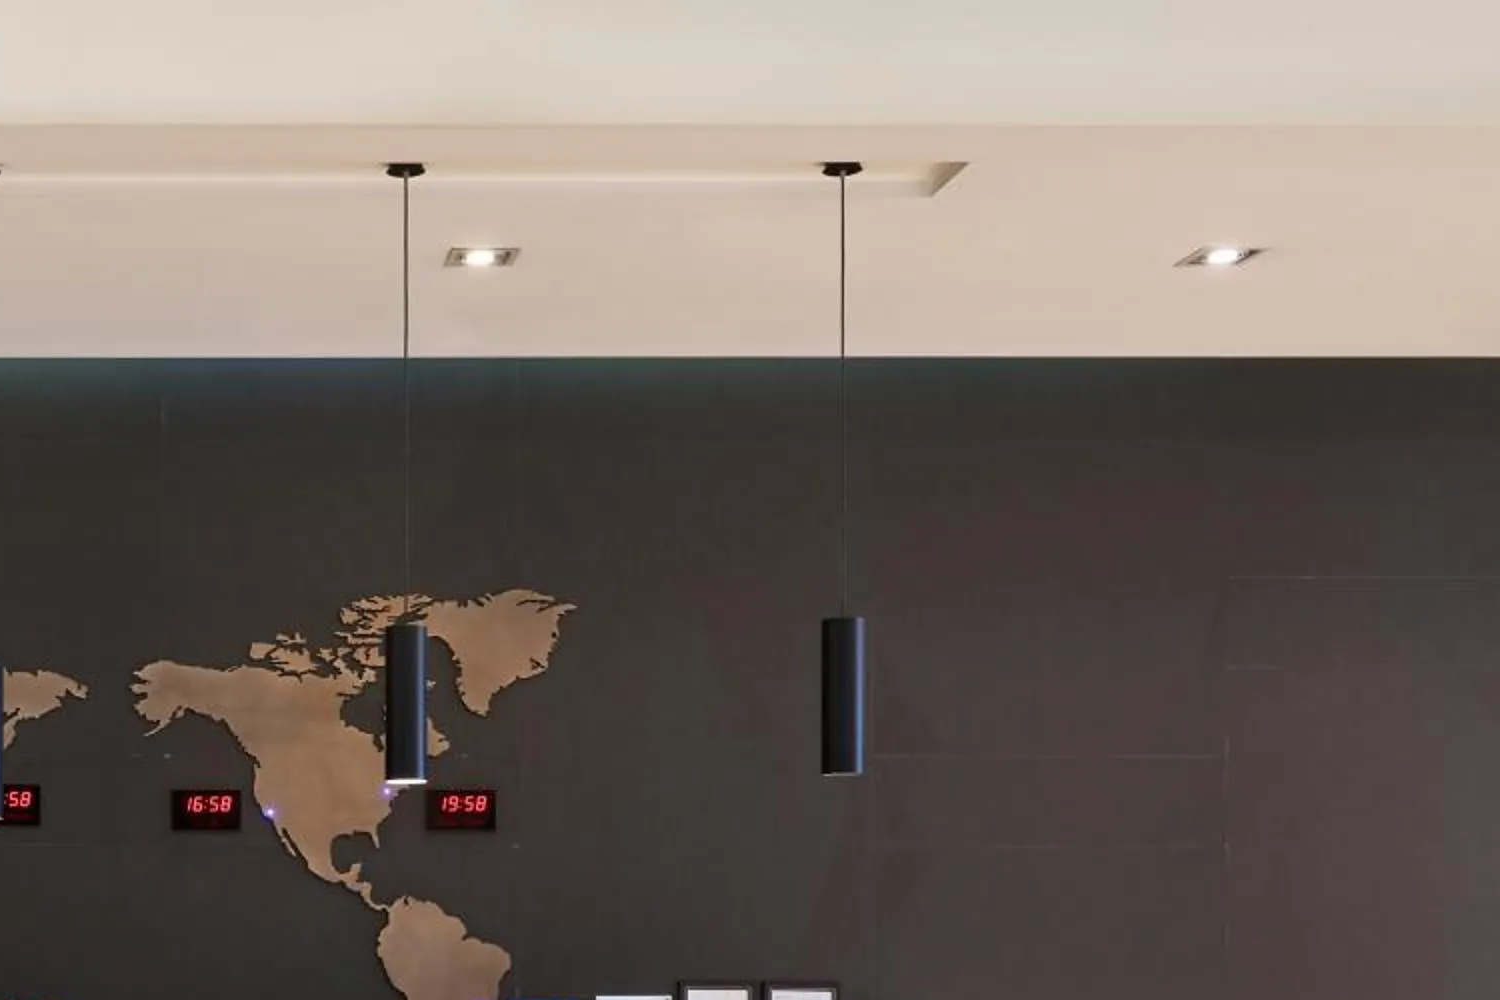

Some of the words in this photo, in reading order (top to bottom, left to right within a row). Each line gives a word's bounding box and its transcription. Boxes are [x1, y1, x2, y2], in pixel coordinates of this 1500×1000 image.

[3, 791, 32, 807] :58
[187, 795, 233, 812] 16:58
[441, 795, 488, 812] 19:58
